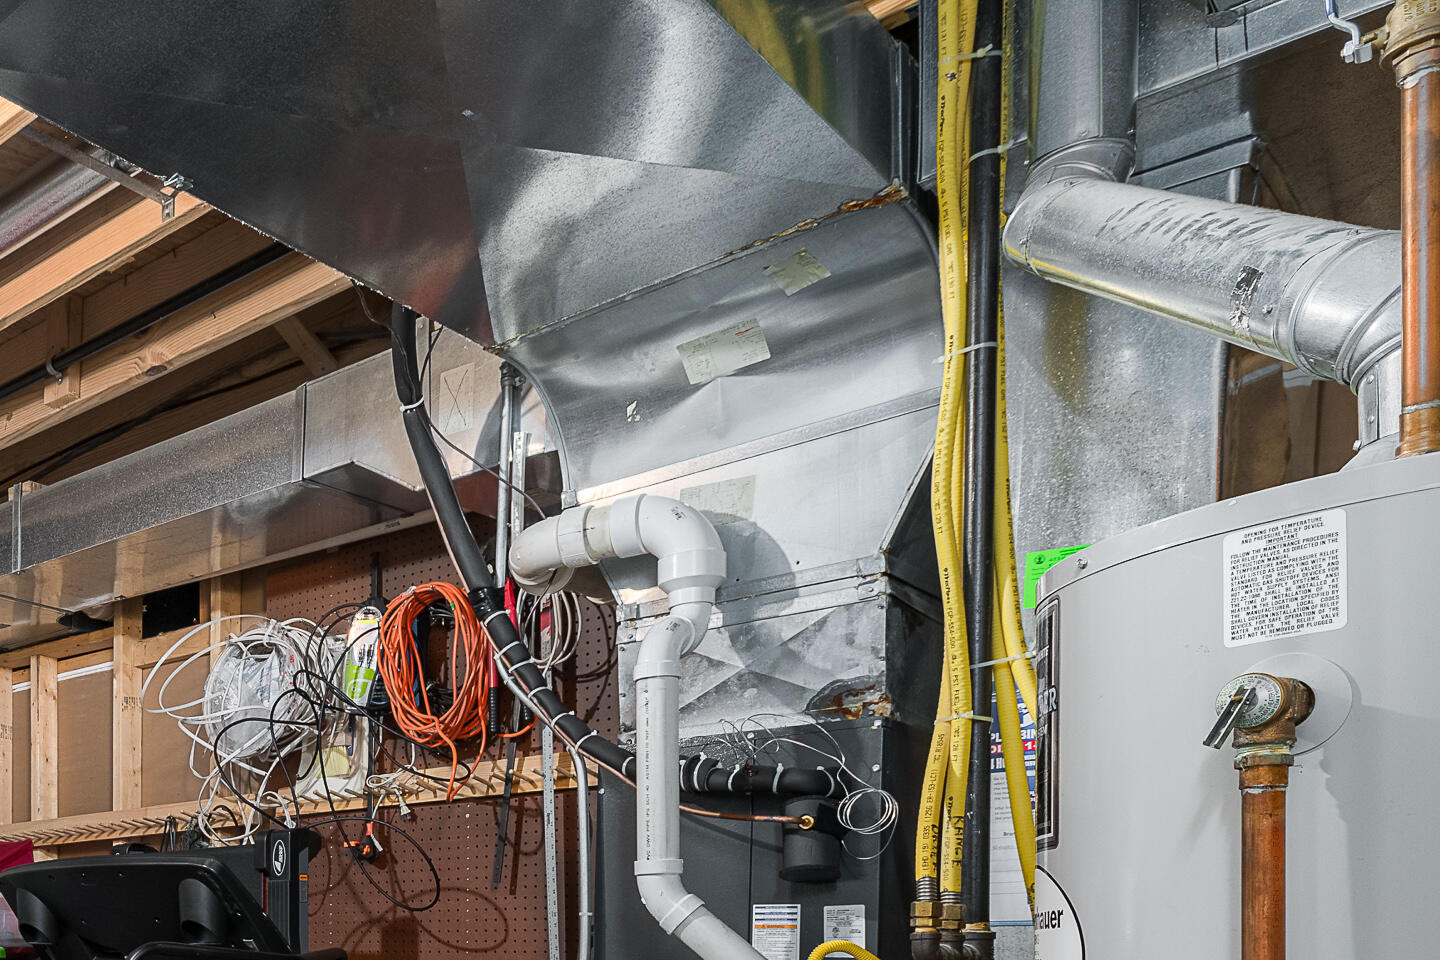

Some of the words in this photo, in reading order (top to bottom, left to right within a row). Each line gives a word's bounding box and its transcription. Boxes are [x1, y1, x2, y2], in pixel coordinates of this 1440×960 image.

[1244, 529, 1266, 539] OPENING
[1281, 516, 1322, 530] TEMPERATURE
[1254, 531, 1281, 542] PRESSURE
[1284, 527, 1301, 535] RELIEF
[1231, 551, 1250, 559] FOLLOW
[1264, 540, 1300, 552] MAINTENANCE
[1303, 532, 1339, 543] PROCEDURES
[1266, 533, 1298, 544] IMPORTANT
[1292, 542, 1318, 551] DIRECTED
[1231, 559, 1264, 570] INSTRUCTION
[1248, 570, 1266, 578] LISTED
[1277, 561, 1309, 571] COMPLYING
[1231, 582, 1260, 592] AUTOMATIC
[1276, 574, 1299, 583] SHUTOFF
[1303, 569, 1325, 578] DEVICES
